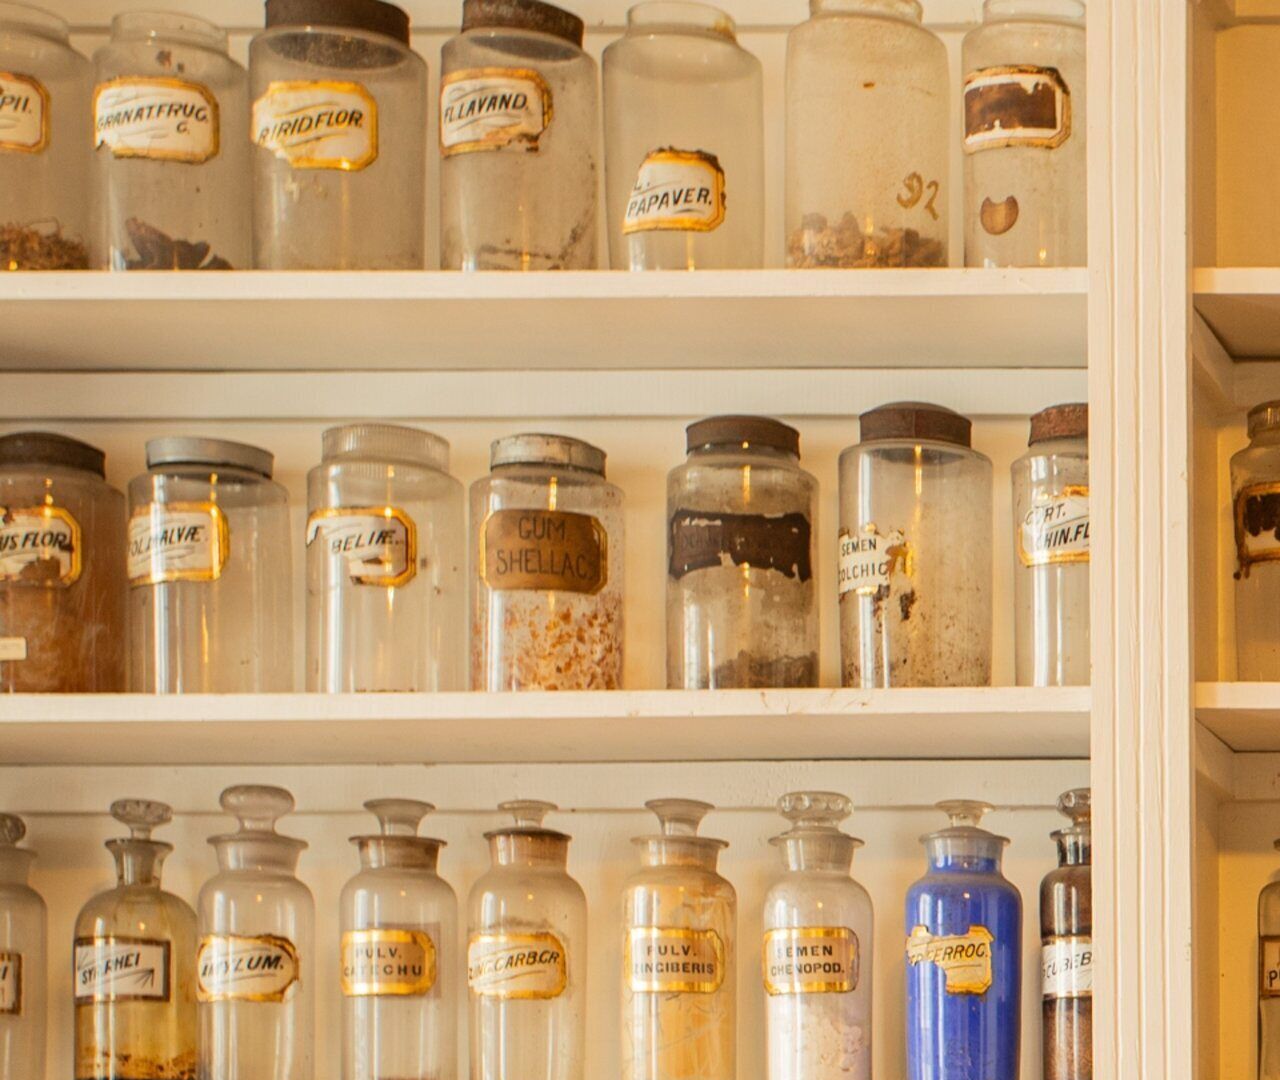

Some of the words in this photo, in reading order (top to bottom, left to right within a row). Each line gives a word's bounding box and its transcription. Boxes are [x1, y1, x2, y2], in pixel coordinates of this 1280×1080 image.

[627, 187, 712, 217] PAPAVER.
[519, 517, 566, 541] GUM
[841, 538, 878, 557] SEMEN
[647, 944, 697, 957] PULV.
[777, 944, 833, 957] SEMEN
[771, 962, 845, 977] CHENOPOD.
